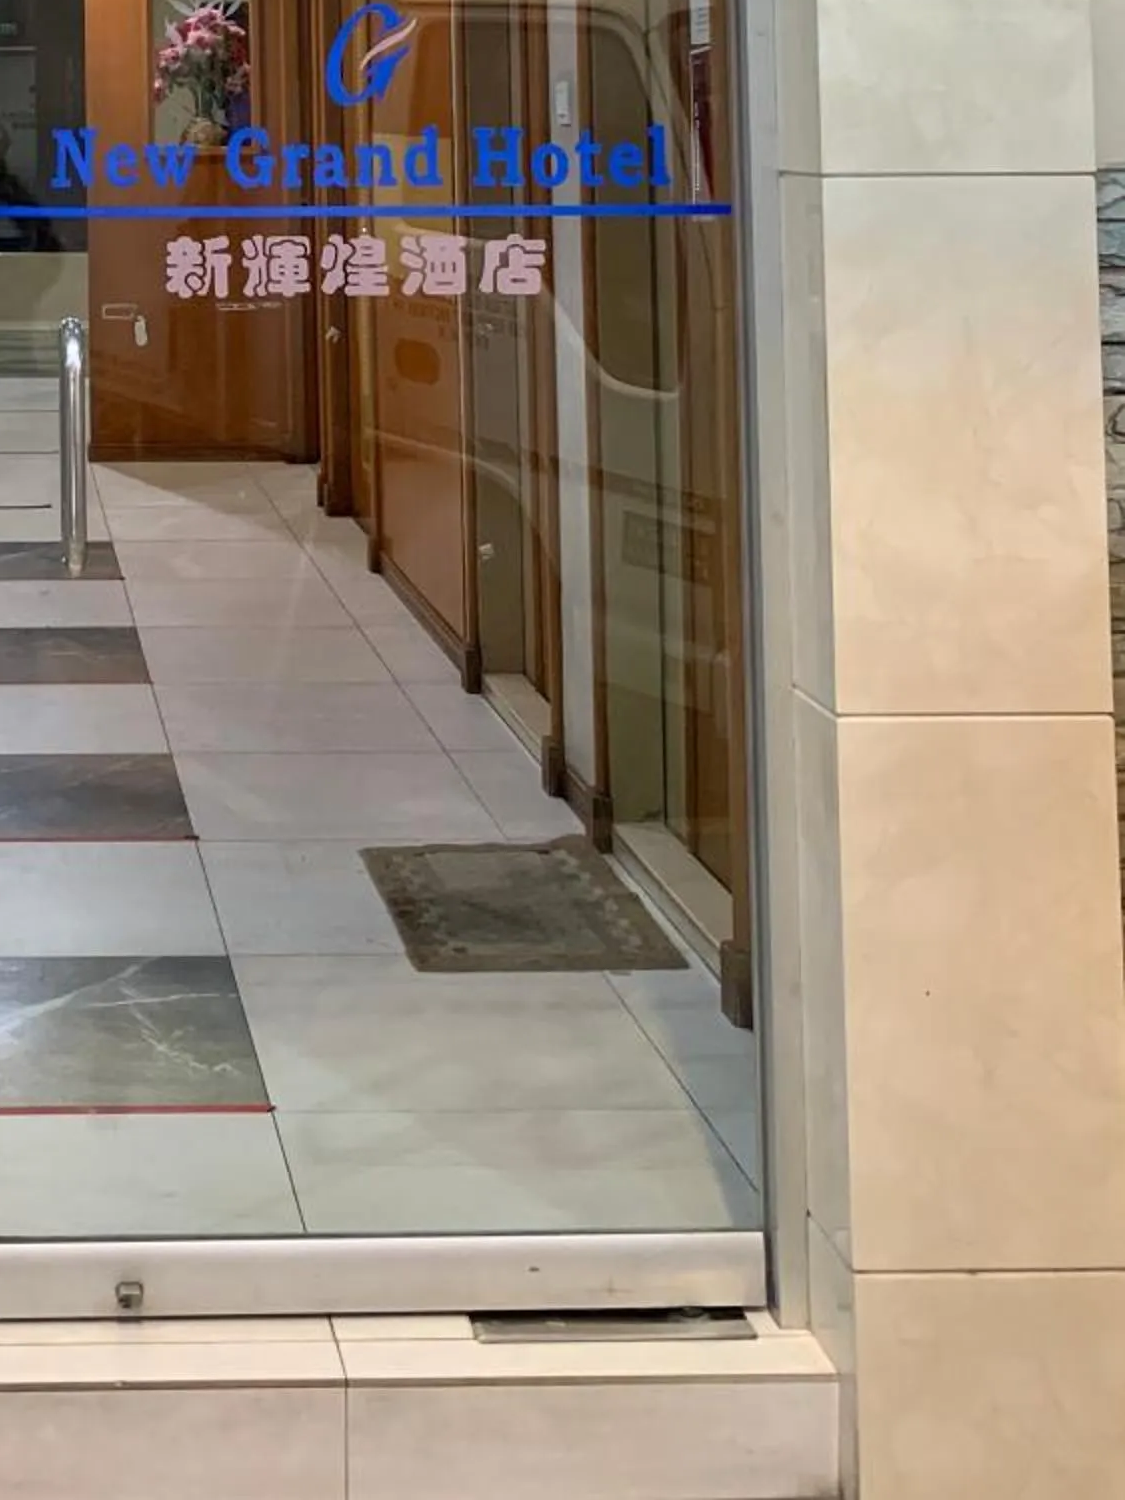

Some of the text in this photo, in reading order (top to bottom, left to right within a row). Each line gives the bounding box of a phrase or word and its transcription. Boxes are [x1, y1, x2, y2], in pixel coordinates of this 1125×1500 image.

[51, 124, 672, 190] New Grand Hotel
[165, 233, 548, 299] 新輝煌酒店
